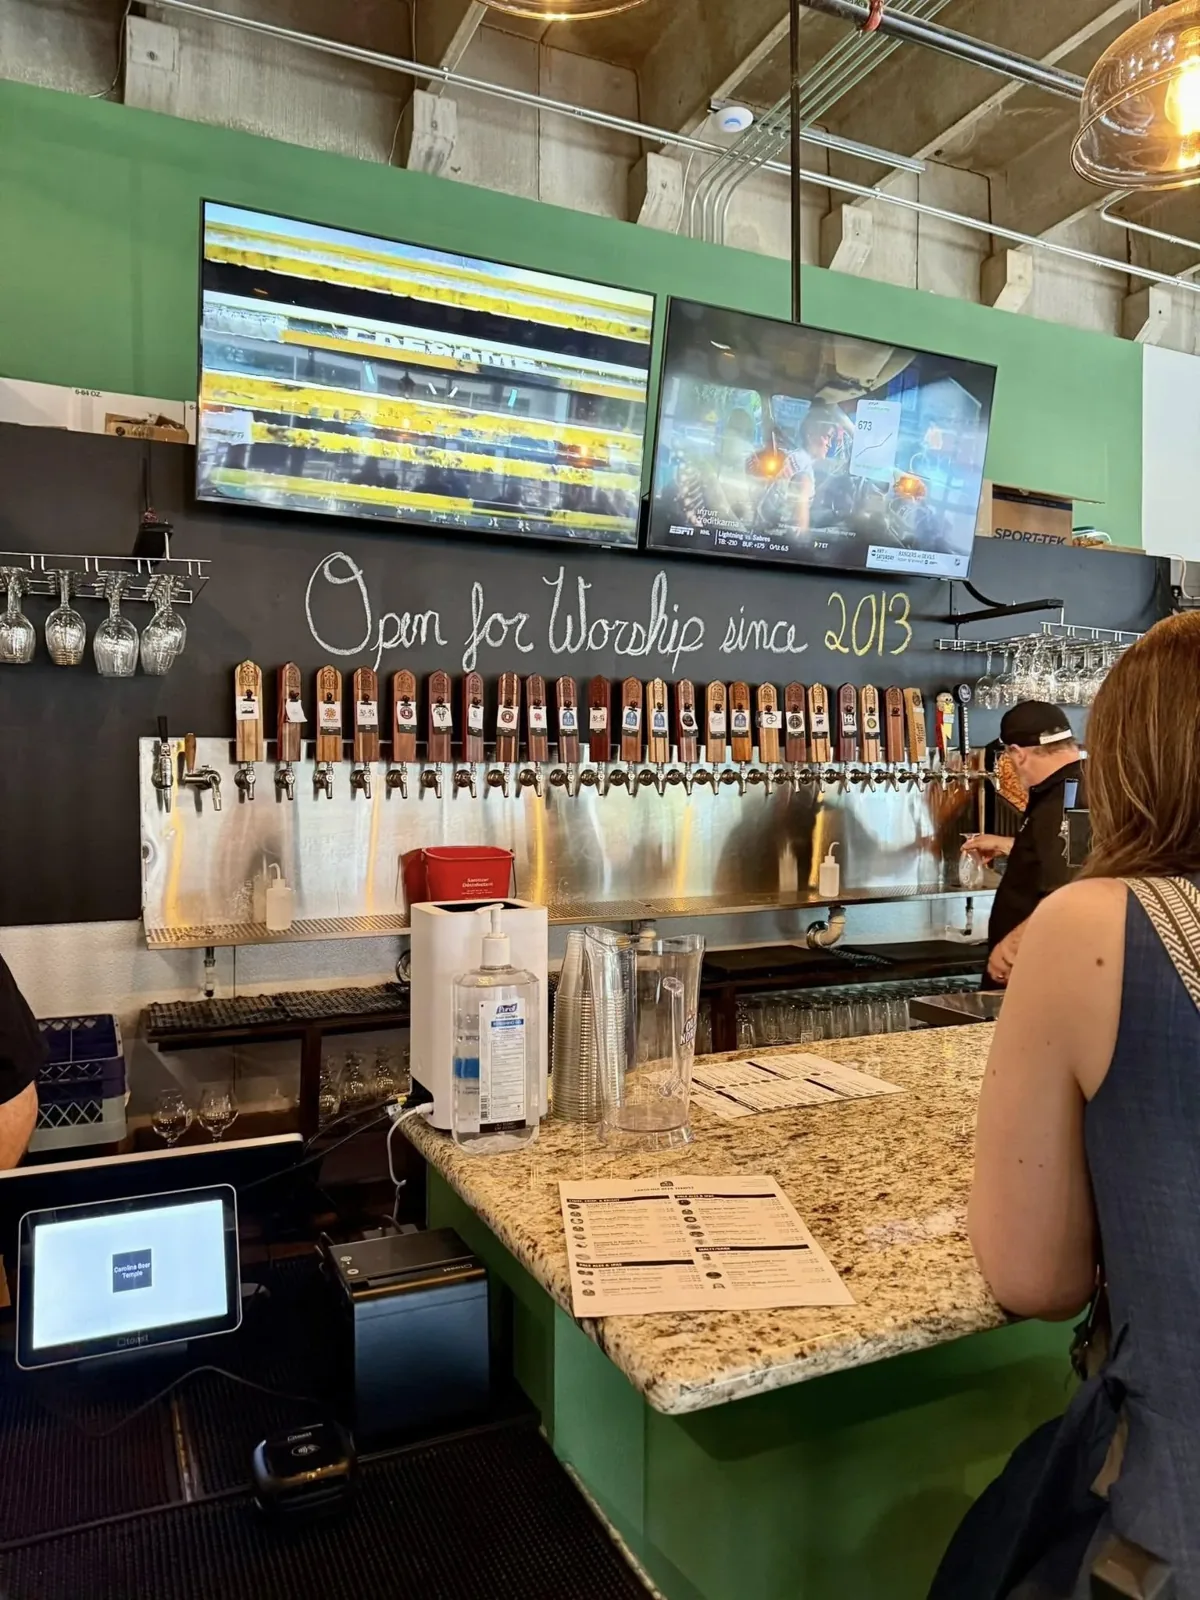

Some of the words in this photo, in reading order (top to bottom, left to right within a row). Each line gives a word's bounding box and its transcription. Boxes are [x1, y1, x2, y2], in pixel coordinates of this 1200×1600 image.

[858, 420, 872, 431] 673
[669, 526, 694, 536] ESPN
[718, 530, 743, 540] Lightning
[752, 534, 770, 542] Sabres
[994, 528, 1066, 545] SPORT-TEK
[305, 551, 448, 672] Open
[462, 581, 534, 673] for
[542, 566, 705, 674] Worship
[719, 605, 808, 653] since
[824, 591, 912, 656] 2013
[114, 1264, 137, 1274] Carolina
[122, 1270, 143, 1279] Temple
